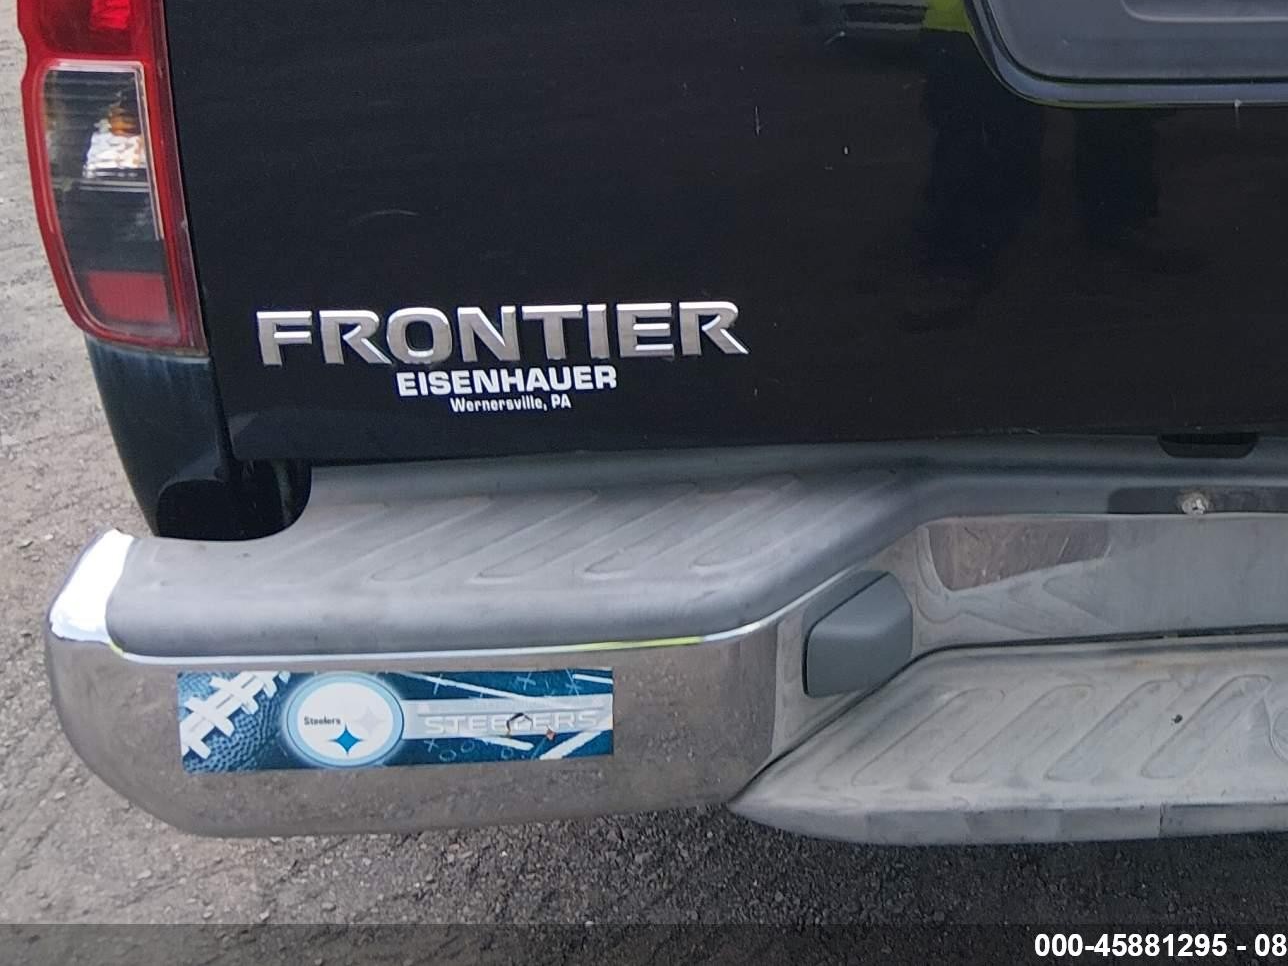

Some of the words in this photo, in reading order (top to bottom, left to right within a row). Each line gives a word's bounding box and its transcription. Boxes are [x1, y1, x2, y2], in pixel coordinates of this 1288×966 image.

[256, 301, 749, 365] FRONTIER
[396, 365, 617, 396] EISENHAUER
[450, 395, 548, 413] Wernersville,
[551, 396, 572, 410] PA
[303, 716, 341, 726] Steelers
